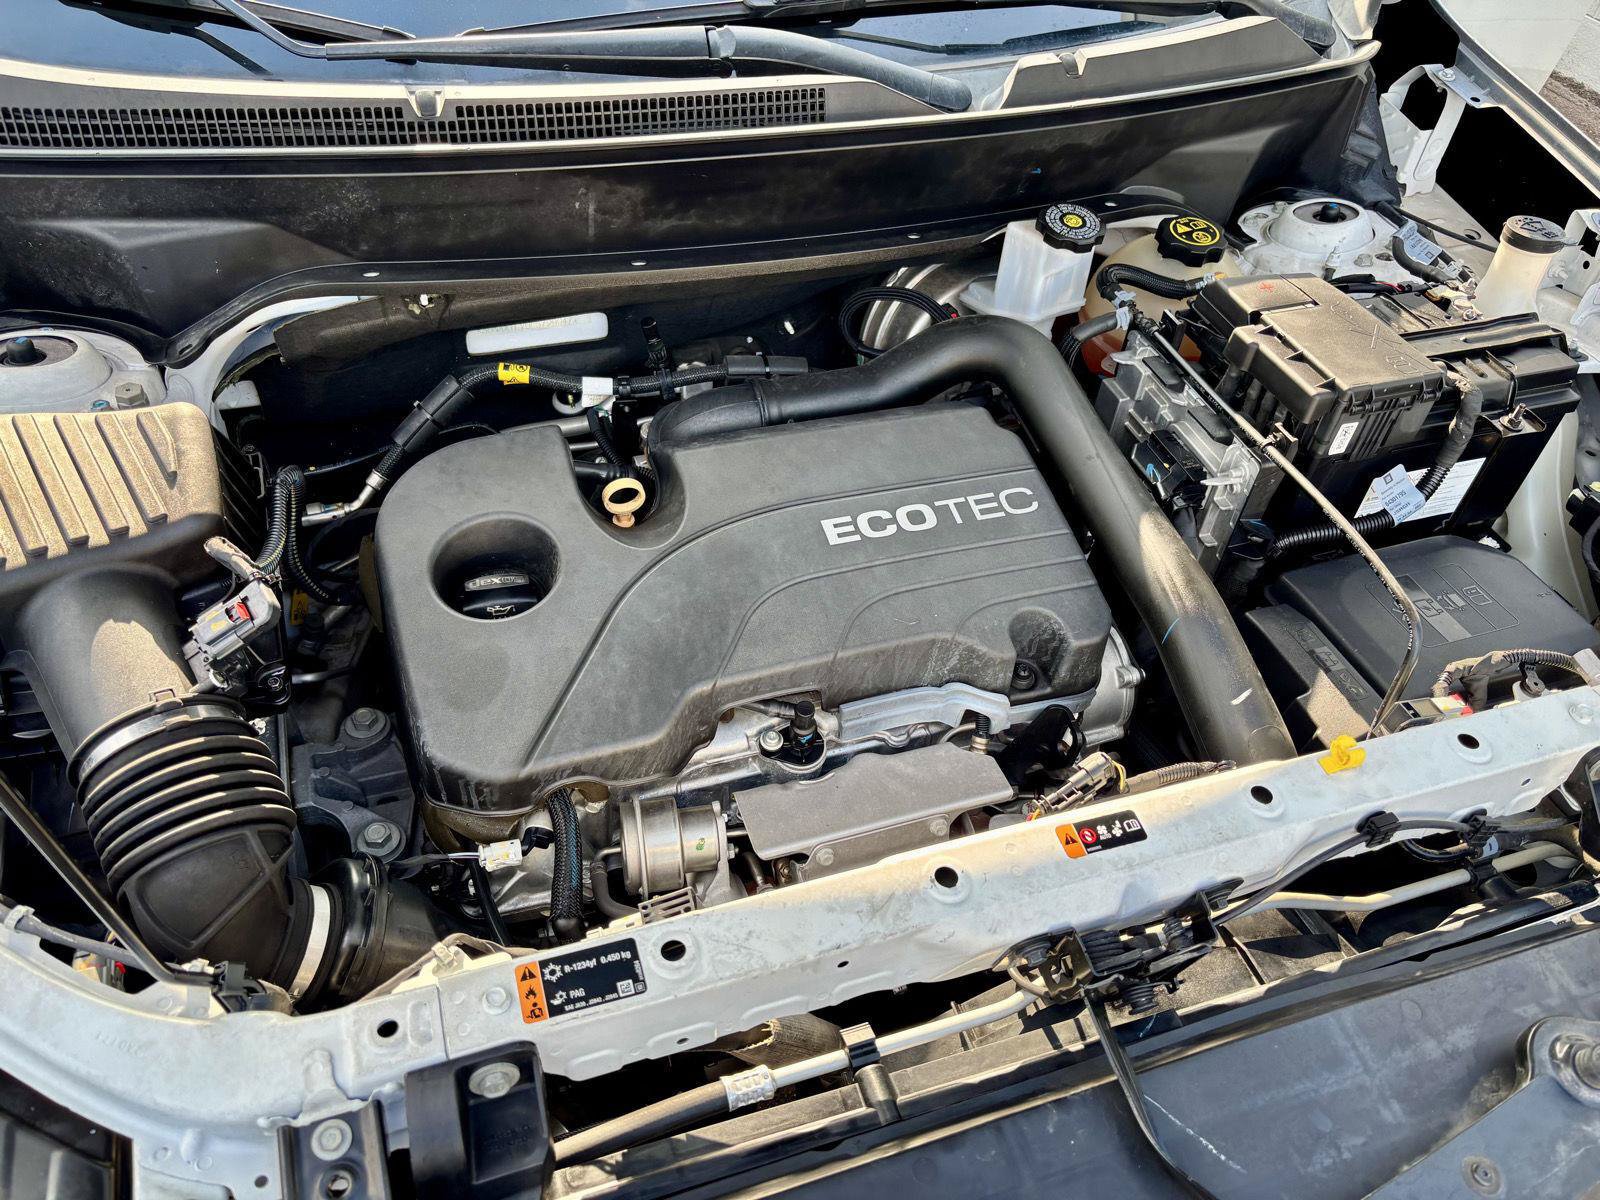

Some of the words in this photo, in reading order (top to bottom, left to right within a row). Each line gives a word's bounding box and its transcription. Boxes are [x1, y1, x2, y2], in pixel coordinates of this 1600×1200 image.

[821, 487, 1039, 546] ECOTEC
[564, 958, 597, 973] R-1234yf
[600, 953, 620, 964] 0.450
[621, 950, 632, 960] kg
[569, 988, 586, 999] PAG
